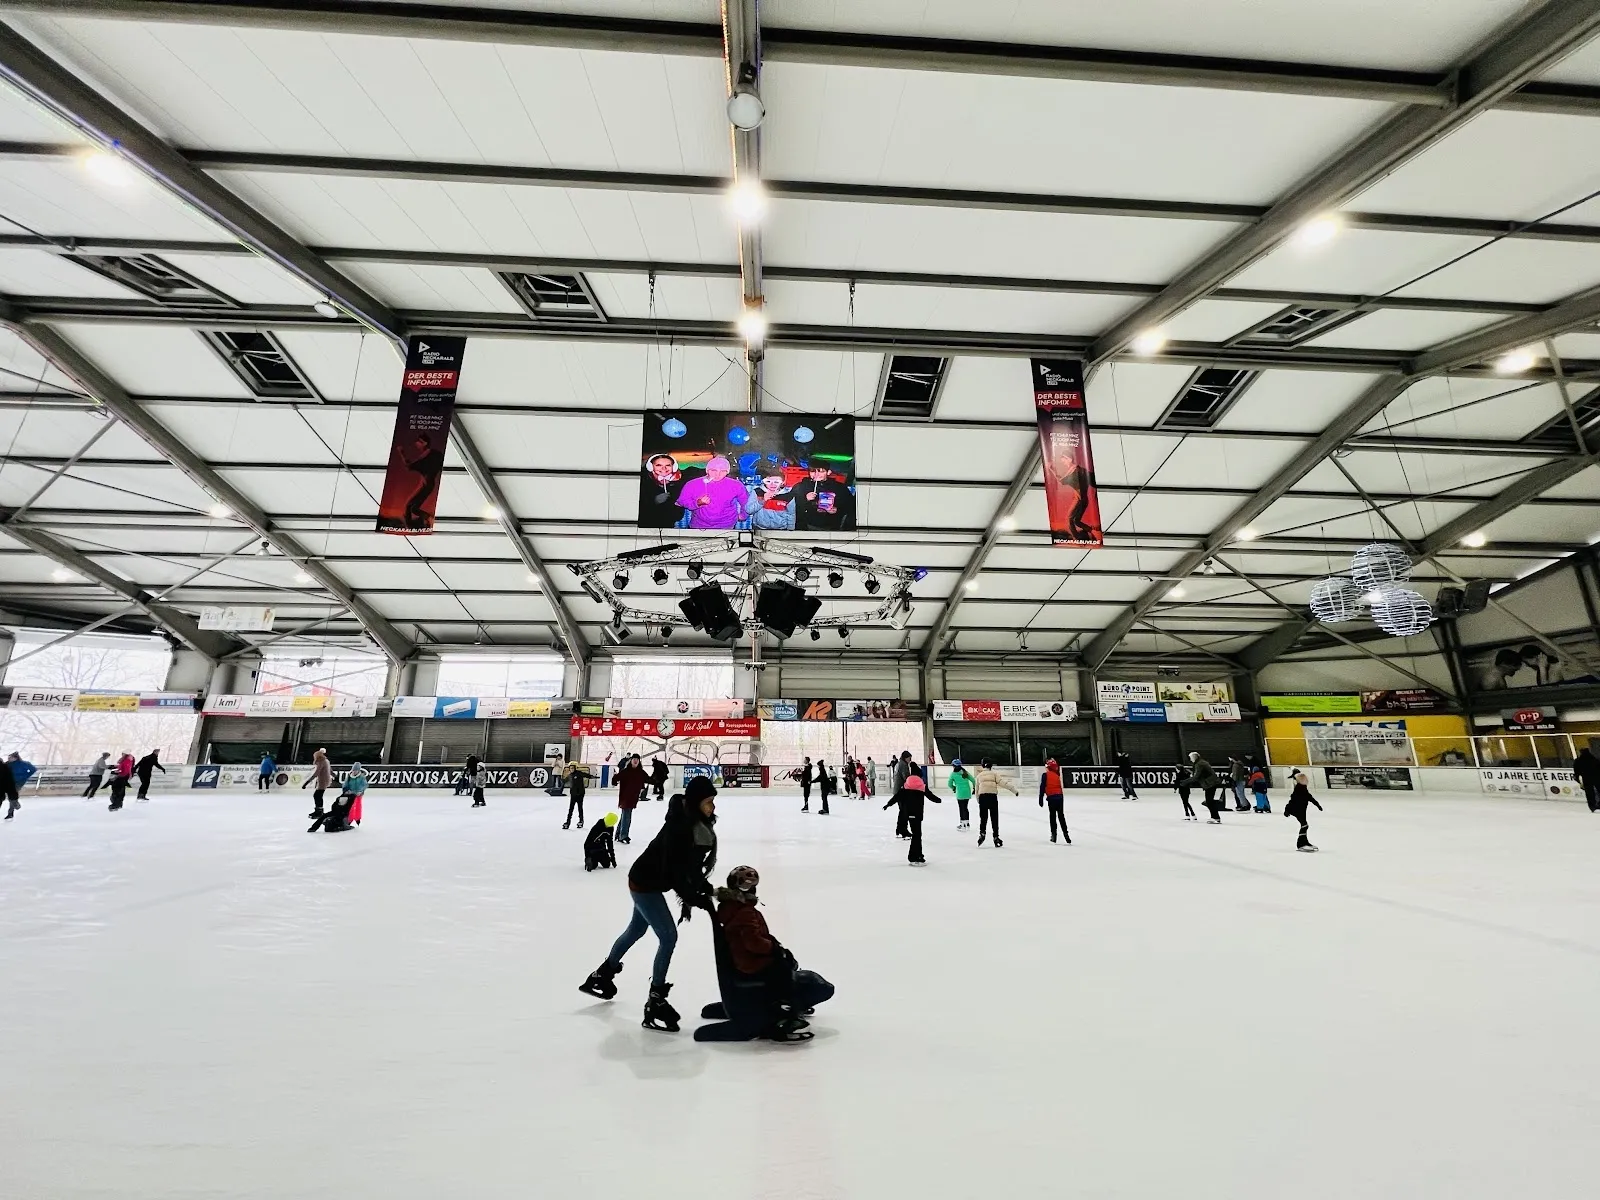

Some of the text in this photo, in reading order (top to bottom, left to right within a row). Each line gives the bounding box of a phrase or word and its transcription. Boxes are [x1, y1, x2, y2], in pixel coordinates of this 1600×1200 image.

[407, 372, 454, 380] DER BESTE
[406, 379, 443, 387] INFOMIX
[1103, 683, 1120, 691] BÜRO
[17, 692, 29, 701] E
[32, 693, 75, 703] BIKE
[218, 698, 238, 707] kml
[262, 700, 290, 708] BIKE
[801, 700, 834, 720] K2
[1012, 704, 1036, 713] BIKE
[1212, 706, 1229, 715] kml
[683, 722, 697, 732] Viel
[194, 769, 217, 783] K2
[1483, 771, 1493, 779] 10
[1497, 771, 1530, 781] JAHRE
[1532, 772, 1549, 781] ICE
